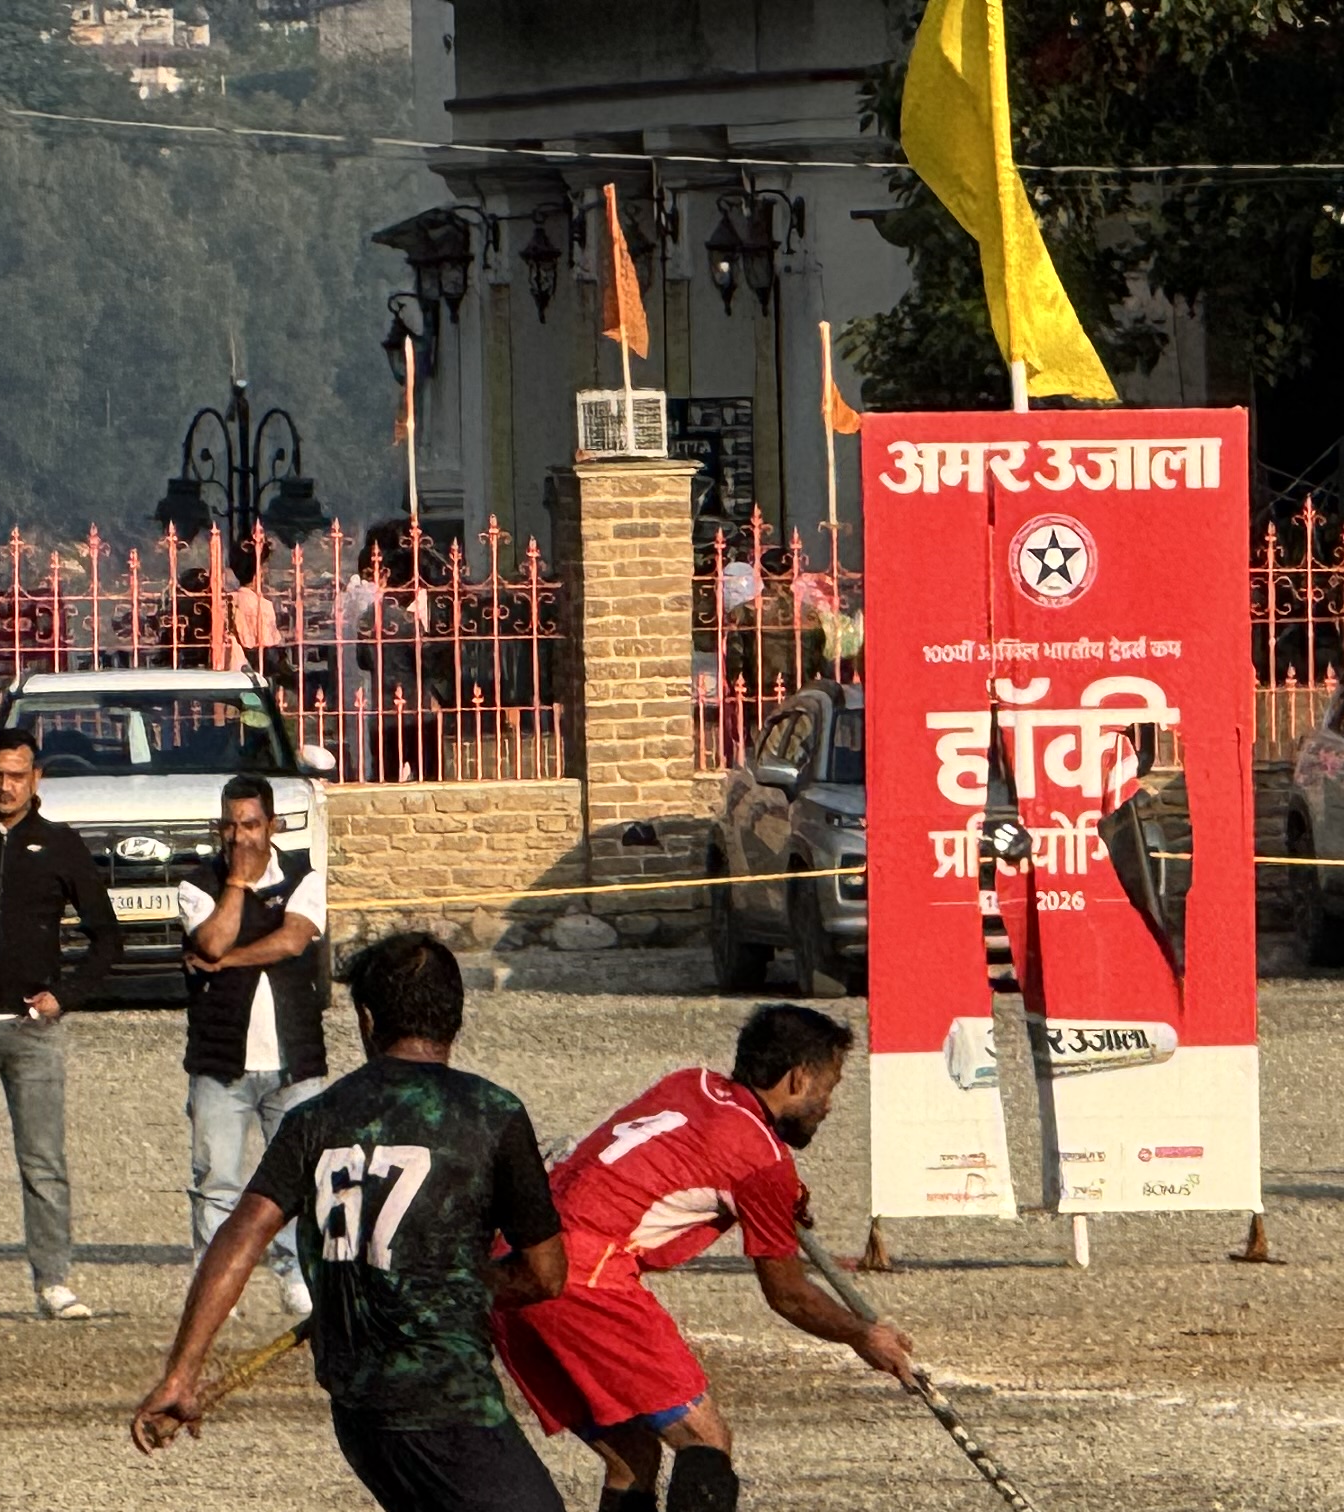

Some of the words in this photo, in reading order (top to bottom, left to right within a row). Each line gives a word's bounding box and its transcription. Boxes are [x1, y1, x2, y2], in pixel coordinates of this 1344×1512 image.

[879, 439, 1031, 495] अमर
[1034, 437, 1223, 492] उजाला
[1036, 890, 1086, 911] 2026
[1067, 1027, 1151, 1054] उजाला
[314, 1143, 432, 1272] 67
